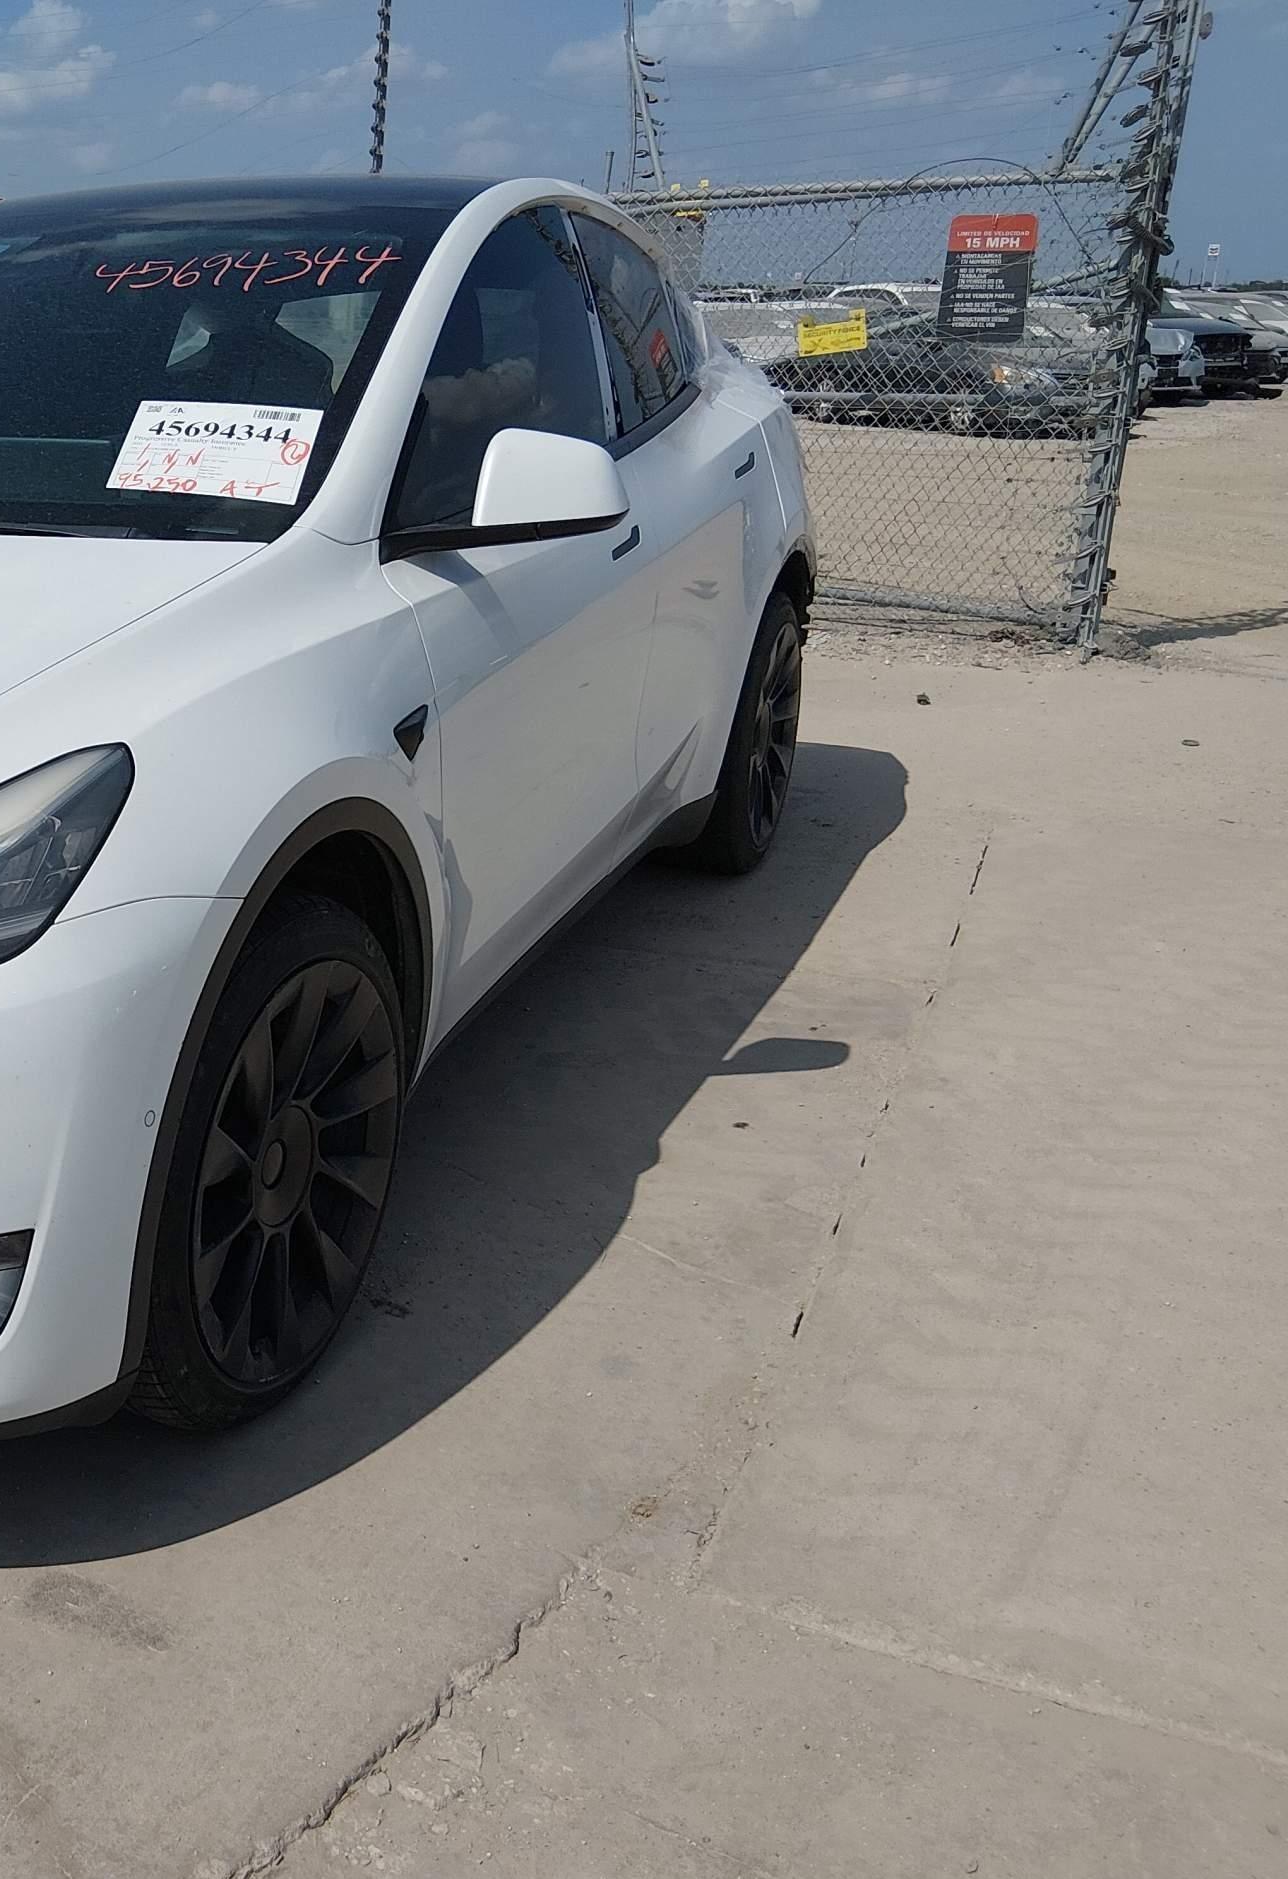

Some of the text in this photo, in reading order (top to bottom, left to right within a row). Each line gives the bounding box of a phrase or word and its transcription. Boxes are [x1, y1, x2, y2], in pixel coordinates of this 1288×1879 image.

[965, 237, 1021, 248] 15 MPH
[96, 246, 401, 294] 45694344
[148, 420, 292, 443] 45694344
